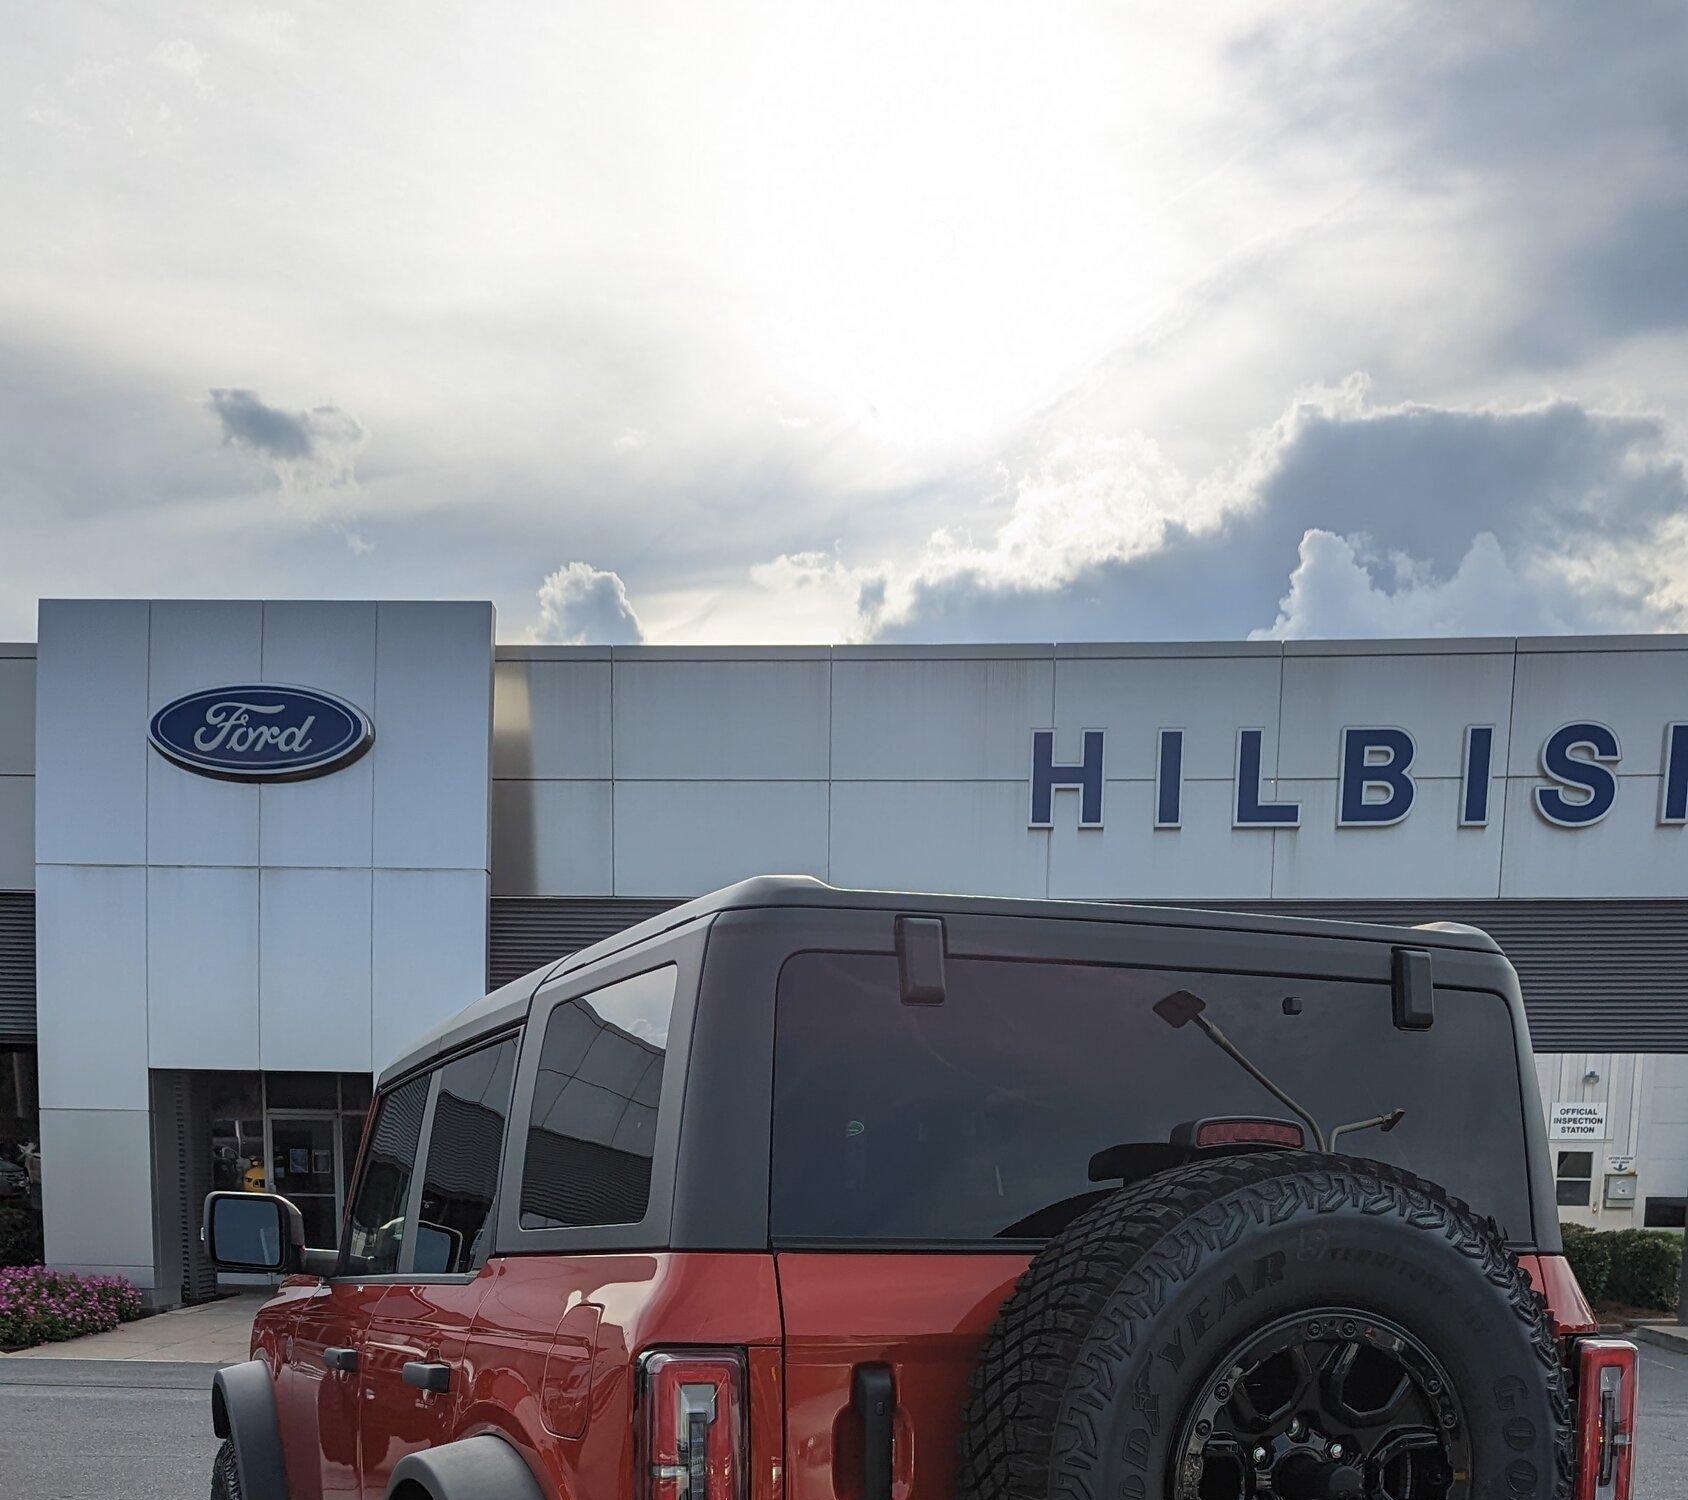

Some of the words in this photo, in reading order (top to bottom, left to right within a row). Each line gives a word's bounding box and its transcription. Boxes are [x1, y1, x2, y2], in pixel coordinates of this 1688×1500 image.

[194, 702, 316, 754] Ford
[1560, 1108, 1598, 1116] OFFICIAL
[1553, 1117, 1603, 1125] INSPECTION
[1560, 1126, 1595, 1134] STATION
